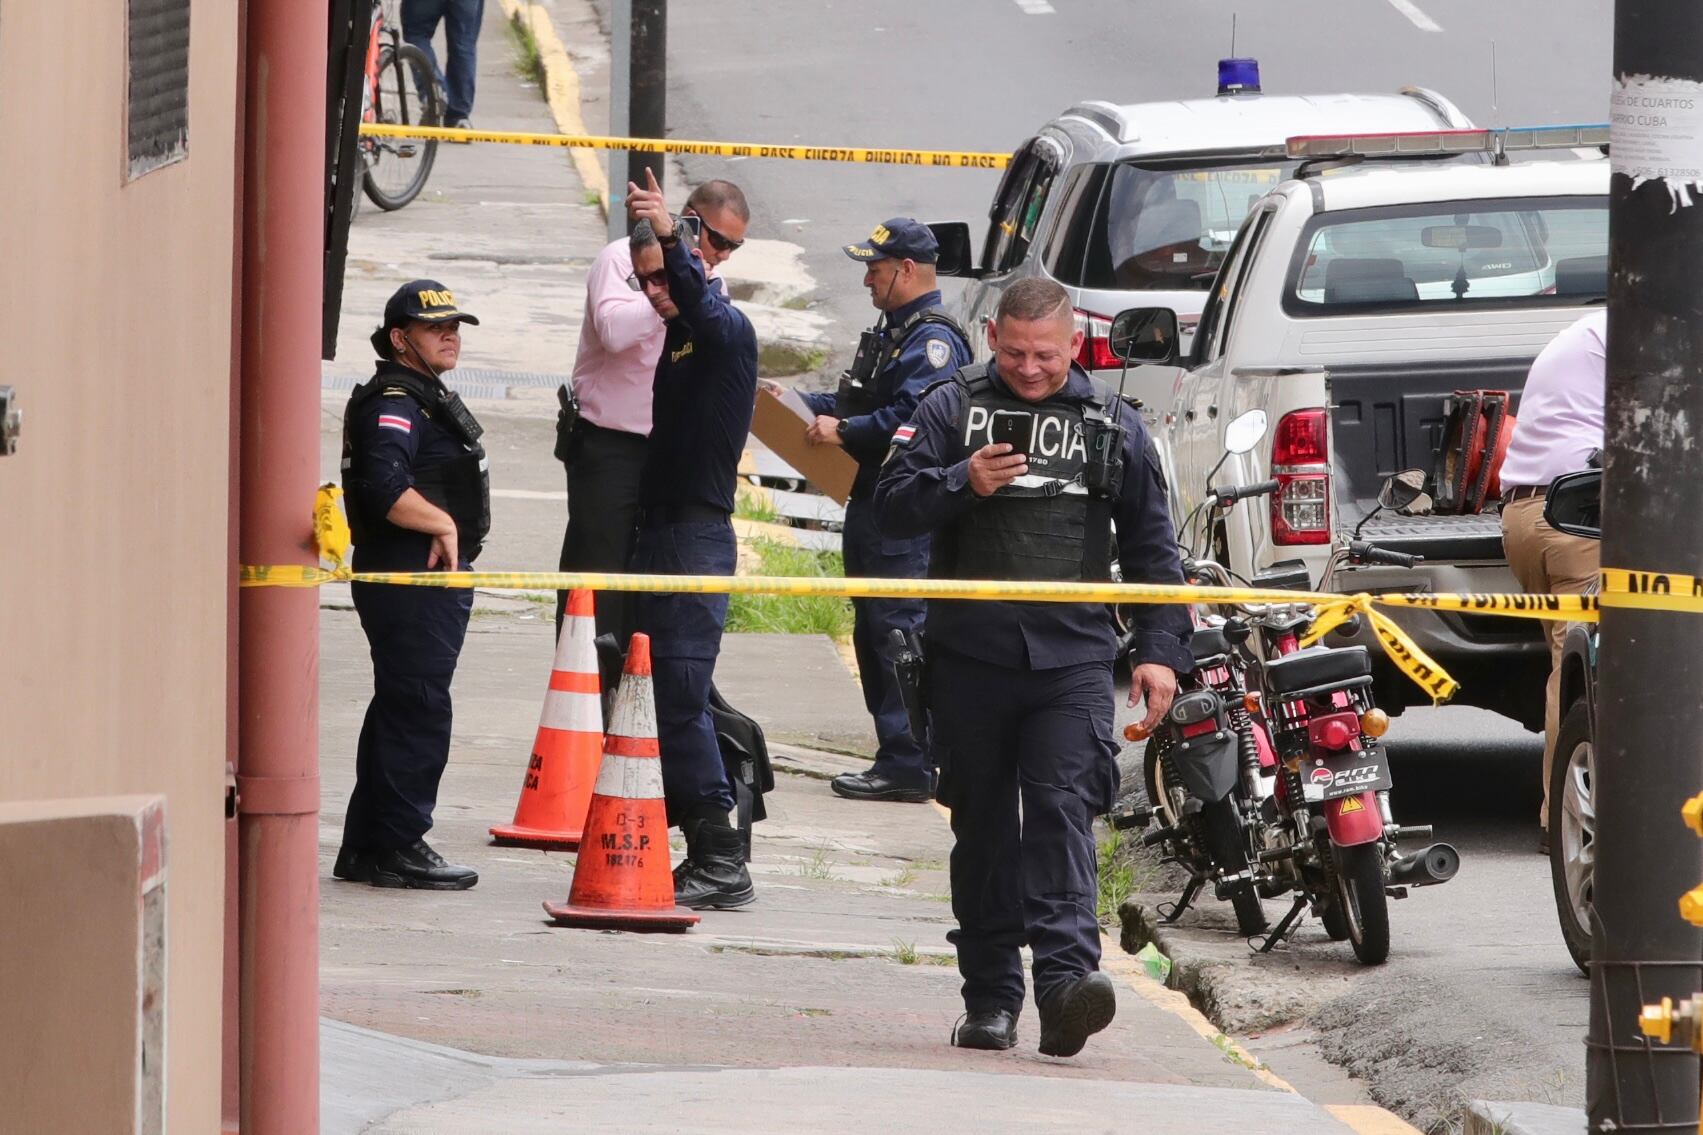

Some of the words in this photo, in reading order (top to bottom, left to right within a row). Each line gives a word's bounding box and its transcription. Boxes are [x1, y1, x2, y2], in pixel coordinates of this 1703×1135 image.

[1642, 98, 1695, 110] CUARTOS
[1638, 115, 1667, 127] CUBA
[964, 406, 1088, 463] PICIA
